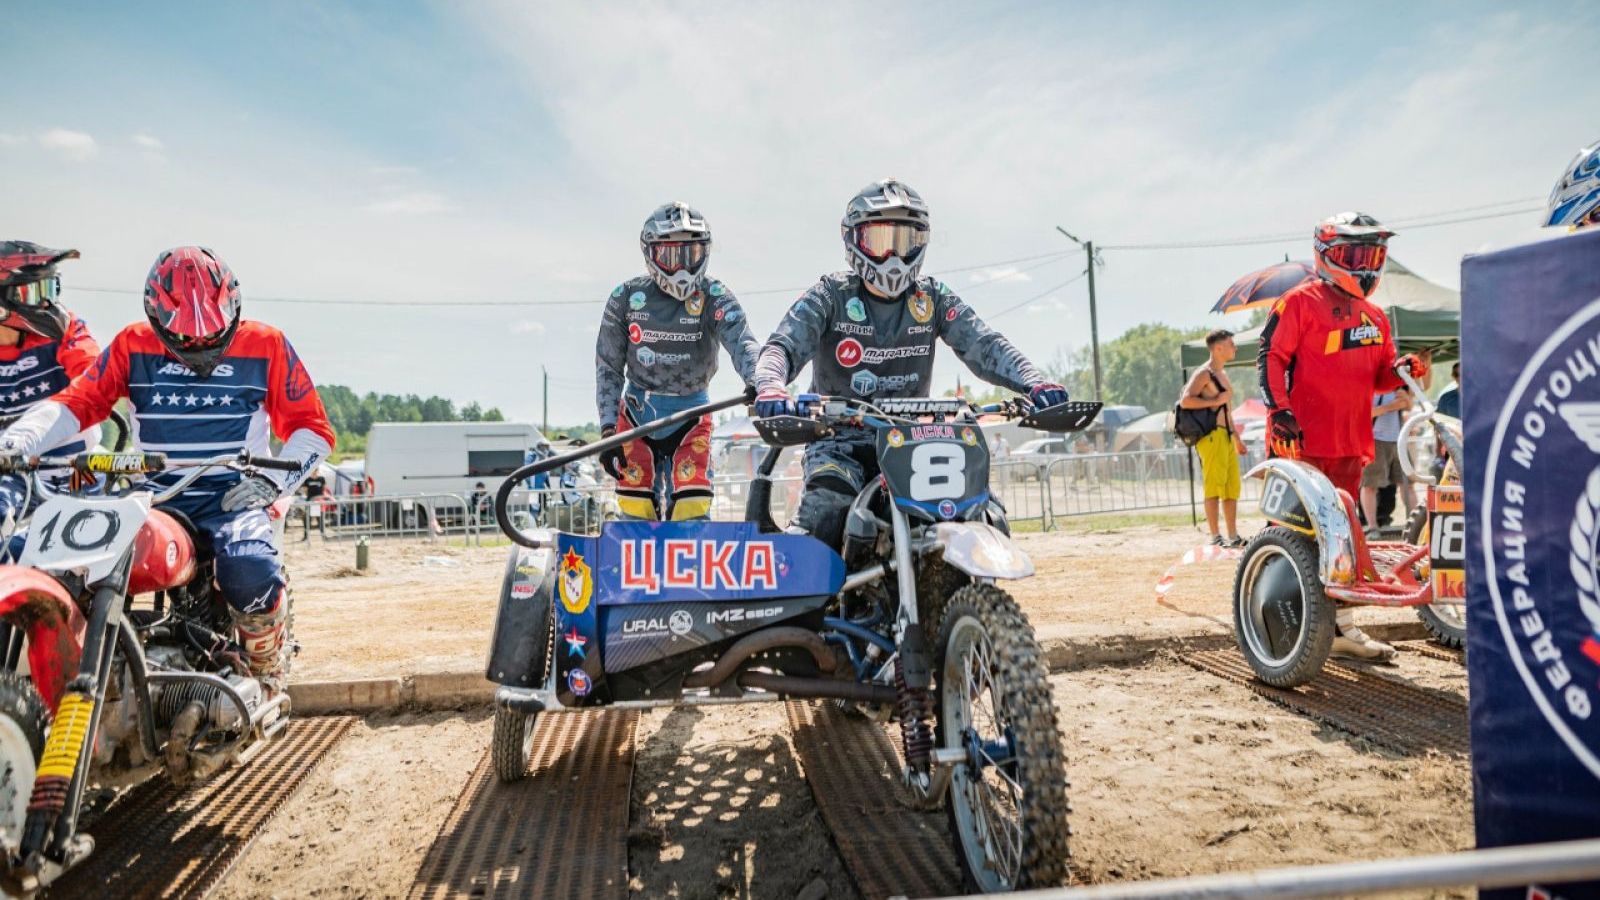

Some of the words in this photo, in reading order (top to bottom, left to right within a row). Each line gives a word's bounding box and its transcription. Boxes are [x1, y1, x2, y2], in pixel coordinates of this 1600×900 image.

[864, 345, 930, 358] MARATHO
[911, 425, 955, 440] ЦСКА
[909, 443, 966, 501] 8
[1260, 475, 1288, 514] 18
[39, 509, 120, 552] 10
[1431, 515, 1465, 560] 18
[620, 538, 777, 595] ЦСКА
[706, 608, 745, 625] IMZ
[1503, 480, 1592, 719] ФЕДЕРАЦИЯ
[623, 618, 668, 633] URAL
